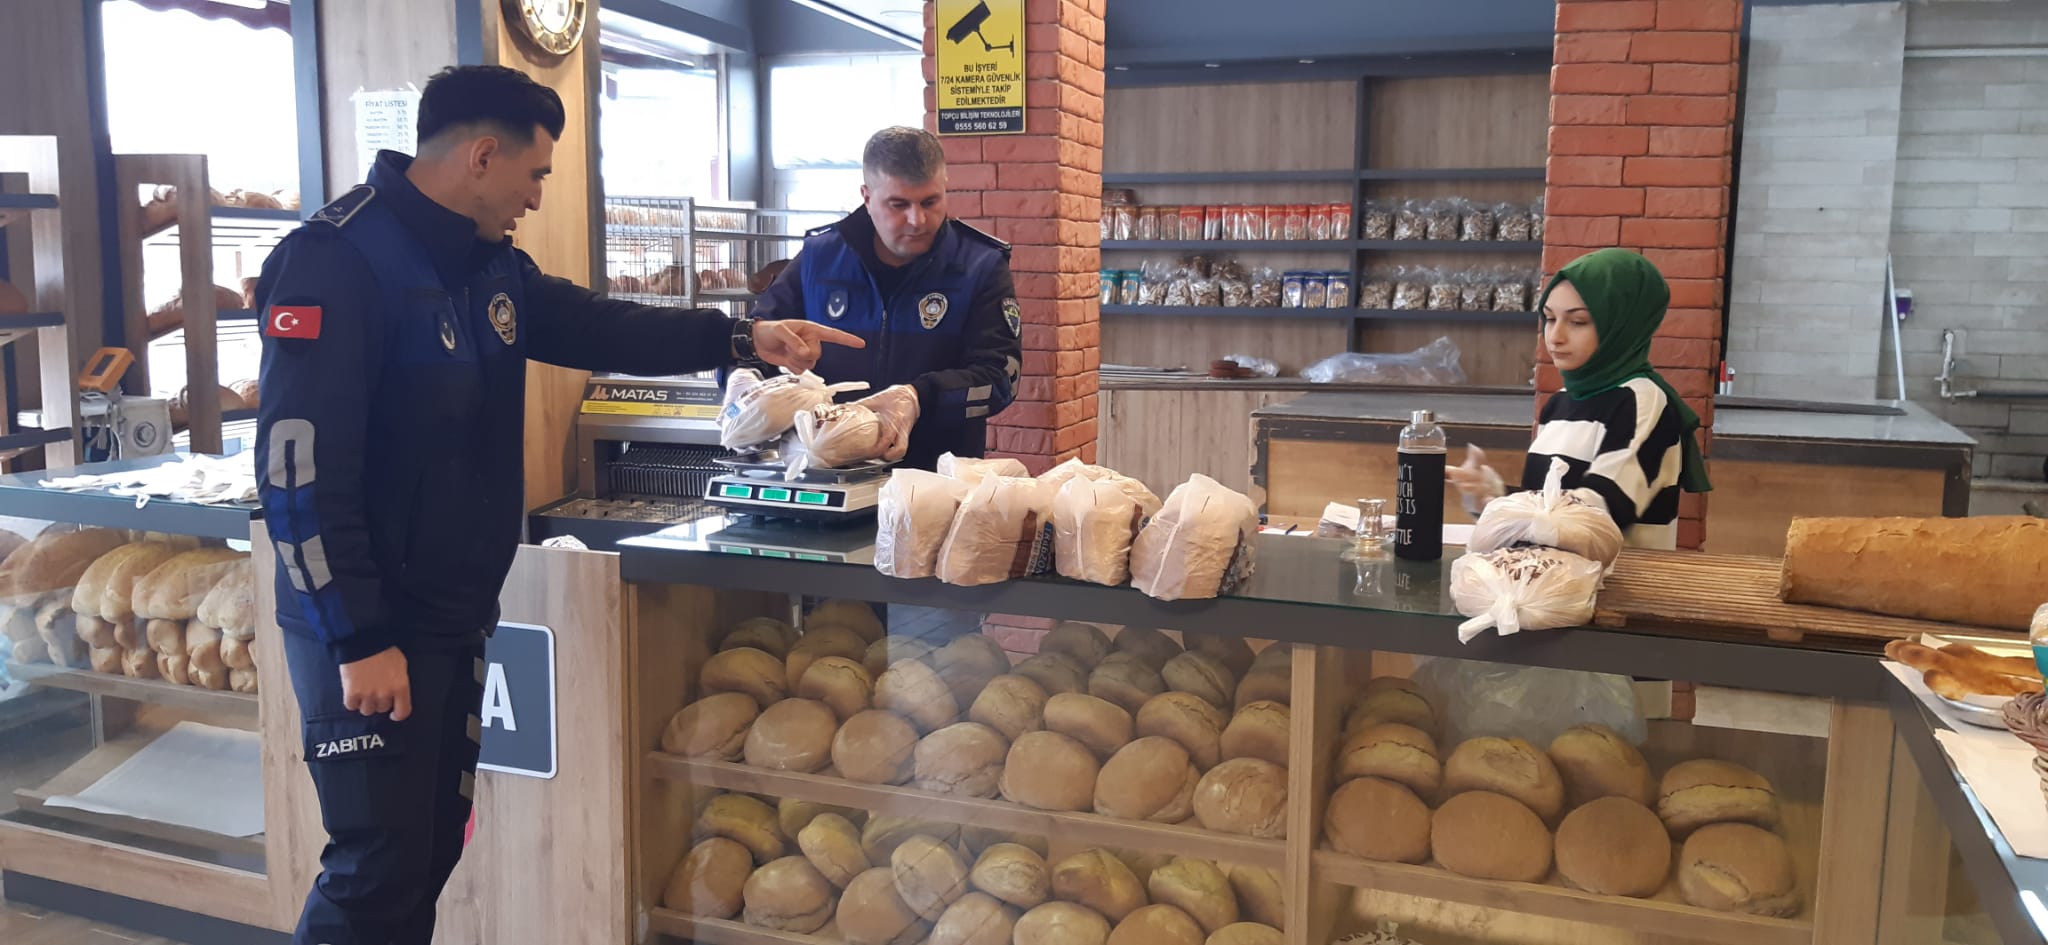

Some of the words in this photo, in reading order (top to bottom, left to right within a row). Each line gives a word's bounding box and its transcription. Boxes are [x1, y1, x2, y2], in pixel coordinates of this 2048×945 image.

[964, 64, 974, 72] BU
[975, 61, 998, 74] İŞYERİ
[941, 76, 954, 84] 7/24
[955, 75, 986, 84] KAMERA
[986, 72, 1021, 83] GÜVENLİK
[950, 85, 991, 95] SİSTEMİYLE
[992, 84, 1012, 93] TAKİP
[956, 95, 1006, 106] EDİLMEKTEDİR
[941, 112, 960, 120] TOPÇU
[954, 122, 972, 131] 0555
[973, 122, 987, 130] 560
[988, 121, 997, 130] 62
[998, 121, 1008, 129] 59
[611, 388, 669, 401] MATAS
[1398, 464, 1413, 480] N'T
[1397, 481, 1413, 498] UCH
[481, 662, 517, 731] A
[316, 733, 385, 758] ZABITA
